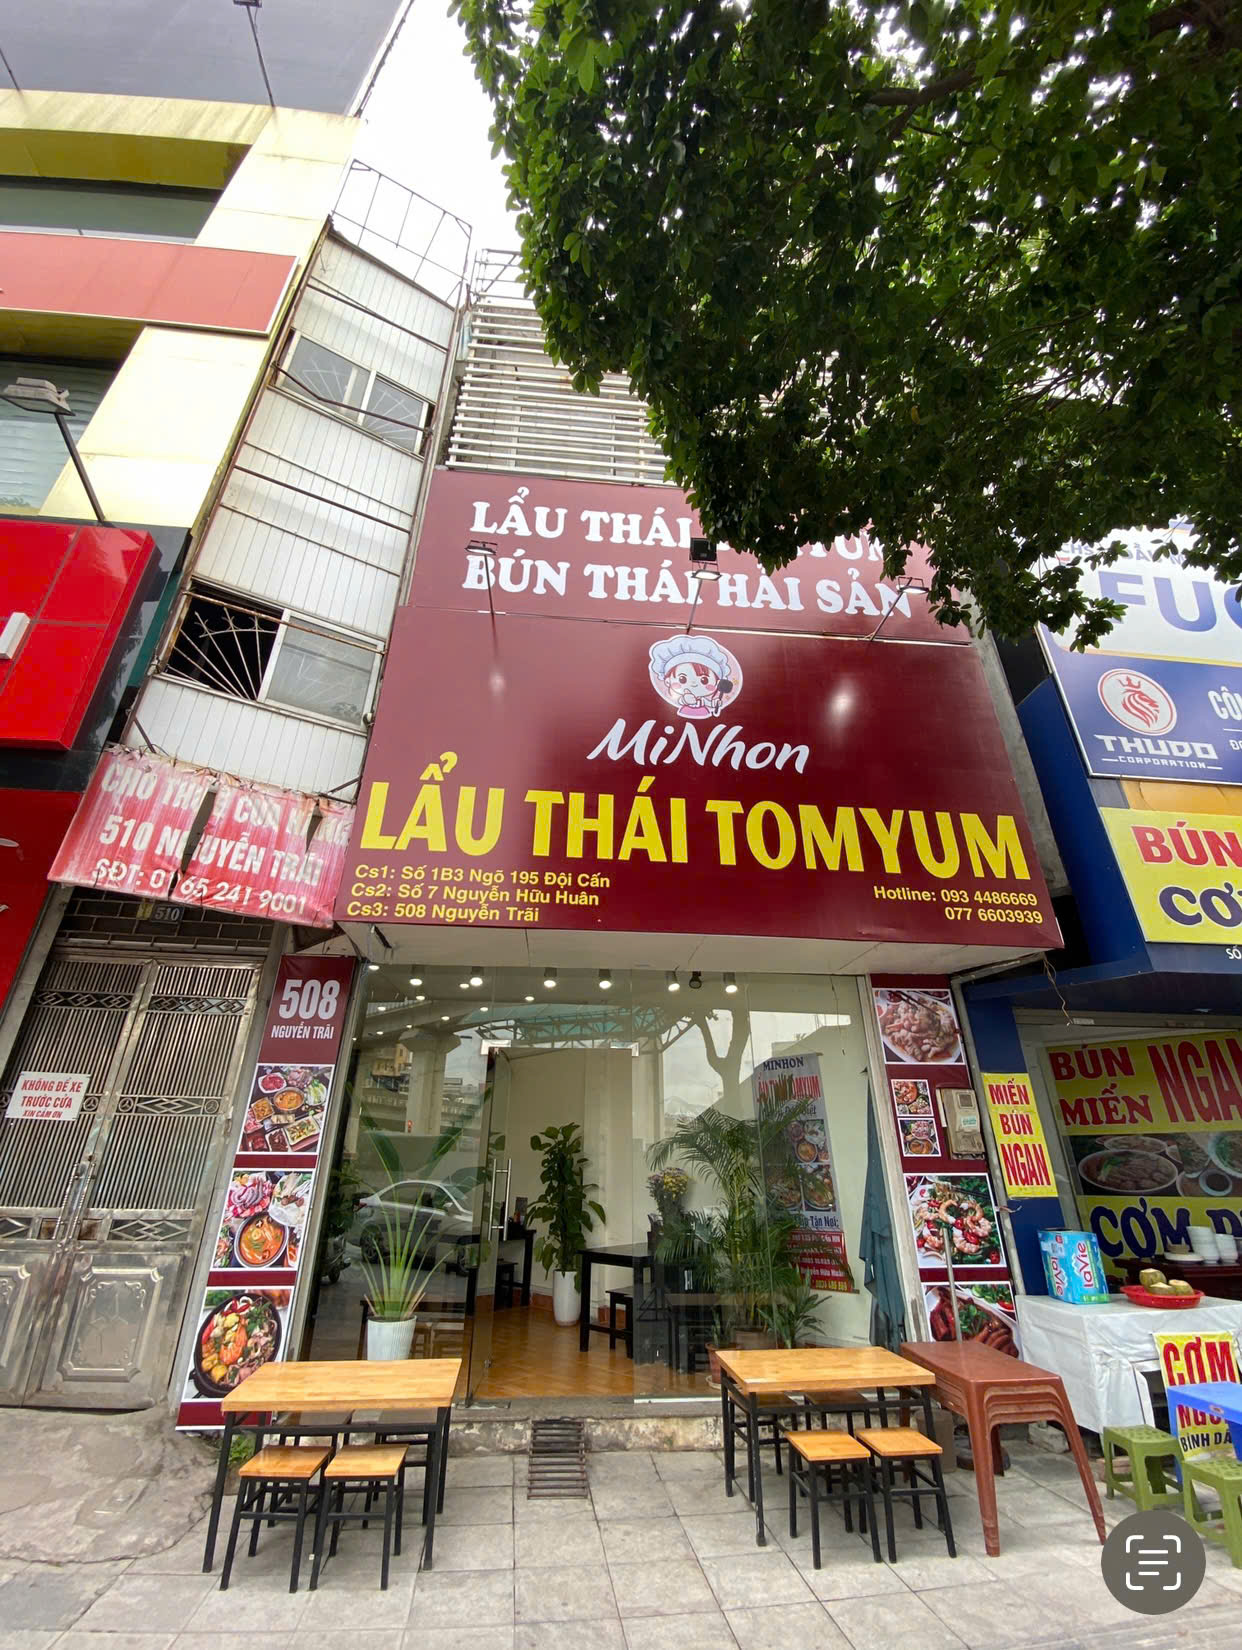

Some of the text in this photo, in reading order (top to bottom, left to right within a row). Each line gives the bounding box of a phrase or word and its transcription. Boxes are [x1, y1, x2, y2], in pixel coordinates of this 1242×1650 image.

[470, 485, 568, 538] LẨU
[580, 506, 694, 549] THÁI
[462, 548, 571, 597] BÚN
[583, 558, 704, 605] THÁI
[816, 567, 912, 618] SẢN
[1118, 755, 1206, 769] CORPORATION
[358, 751, 1031, 881] LẨU THÁI TOMYUM
[99, 814, 155, 852] 510
[1130, 820, 1242, 869] BÚN
[91, 857, 144, 886] SĐT:
[213, 881, 250, 905] 241
[258, 889, 306, 915] 9001
[354, 864, 611, 889] Cs1: Số 1B3 Ngõ 195 Đội Cấn
[350, 882, 600, 906] Cs2: Số 7 Nguyễn Hữu Huân
[873, 885, 1038, 907] Hotline: 093 4486669
[1158, 881, 1242, 929] CƠ
[154, 906, 181, 921] 510
[346, 901, 540, 923] Cs3: 508 Nguyễn Trãi
[944, 906, 1044, 925] 077 6603939
[278, 979, 341, 1020] 508
[271, 1021, 335, 1040] NGUYỄN TRÃI
[763, 1056, 805, 1072] MINHON
[1048, 1043, 1135, 1081] BÚN
[21, 1077, 54, 1092] KHÔNG
[69, 1081, 84, 1093] XE
[988, 1077, 1030, 1106] MIẾN
[21, 1093, 52, 1108] TRƯỚC
[22, 1109, 37, 1118] XIN
[1058, 1082, 1155, 1127] MIẾN
[999, 1110, 1034, 1136] BÚN
[1000, 1142, 1052, 1187] NGAN
[1090, 1197, 1192, 1259] CƠM
[1162, 1336, 1237, 1387] CƠM
